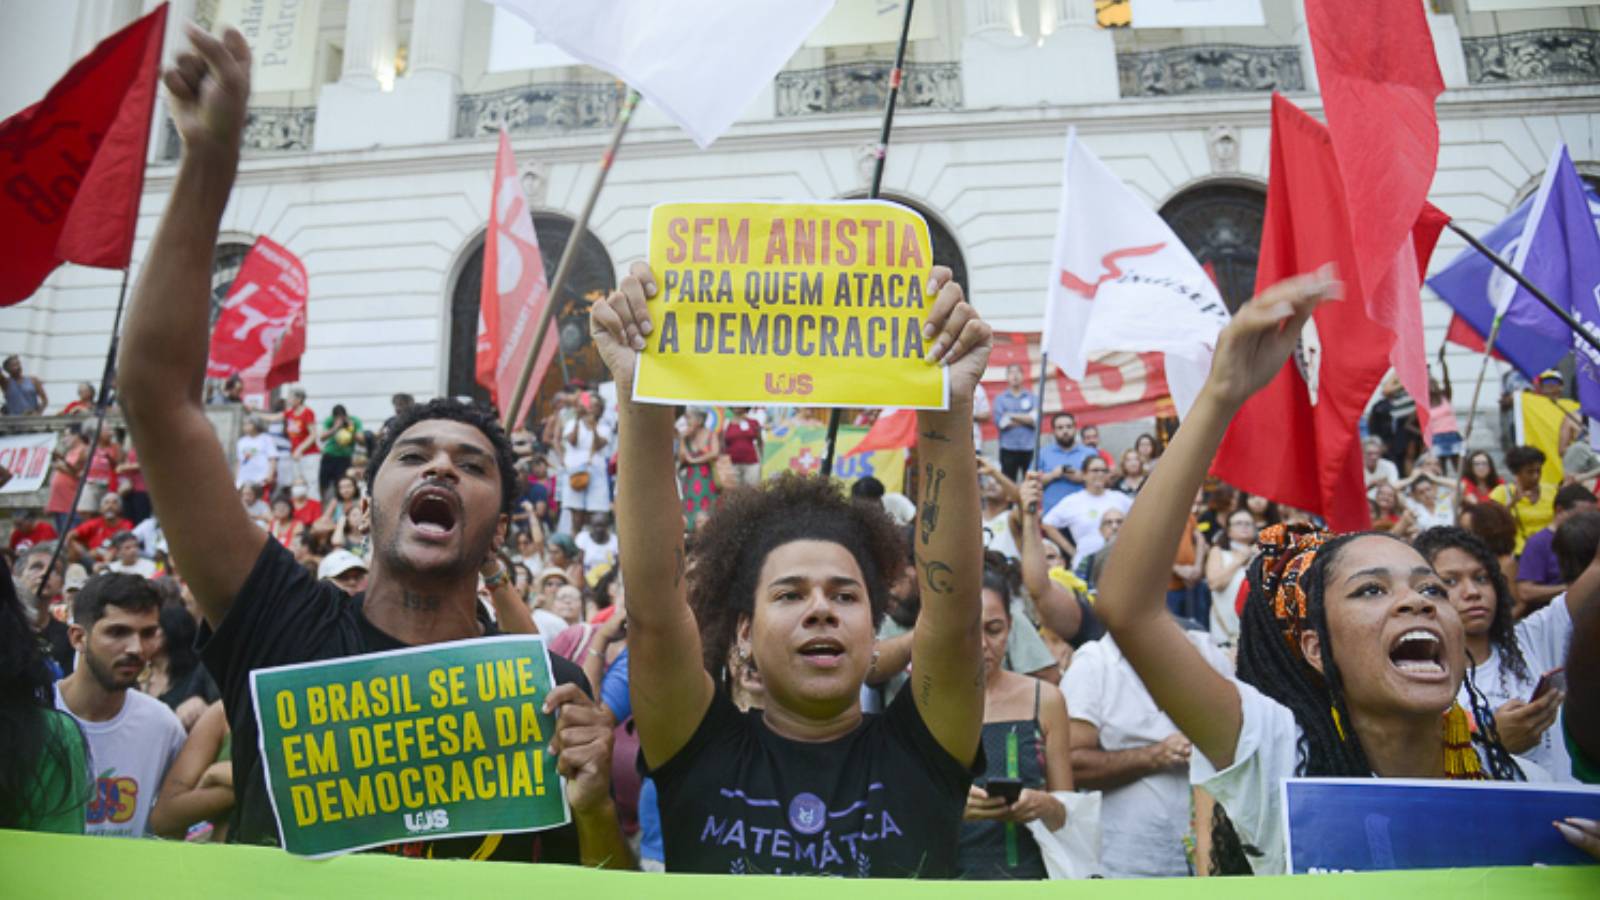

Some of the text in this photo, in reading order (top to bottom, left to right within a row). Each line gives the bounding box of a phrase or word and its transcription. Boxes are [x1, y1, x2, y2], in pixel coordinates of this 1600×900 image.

[666, 217, 924, 269] SEM ANISTIA
[663, 269, 924, 311] PARA QUEM ATACA
[658, 311, 925, 360] A DEMOCRACIA
[836, 451, 875, 478] US
[276, 657, 536, 730] O BRASIL SE UNE
[282, 702, 543, 779] EM DEFESA DA
[290, 749, 545, 827] DEMOCRACIA!
[701, 810, 903, 869] MATEMÁTCA
